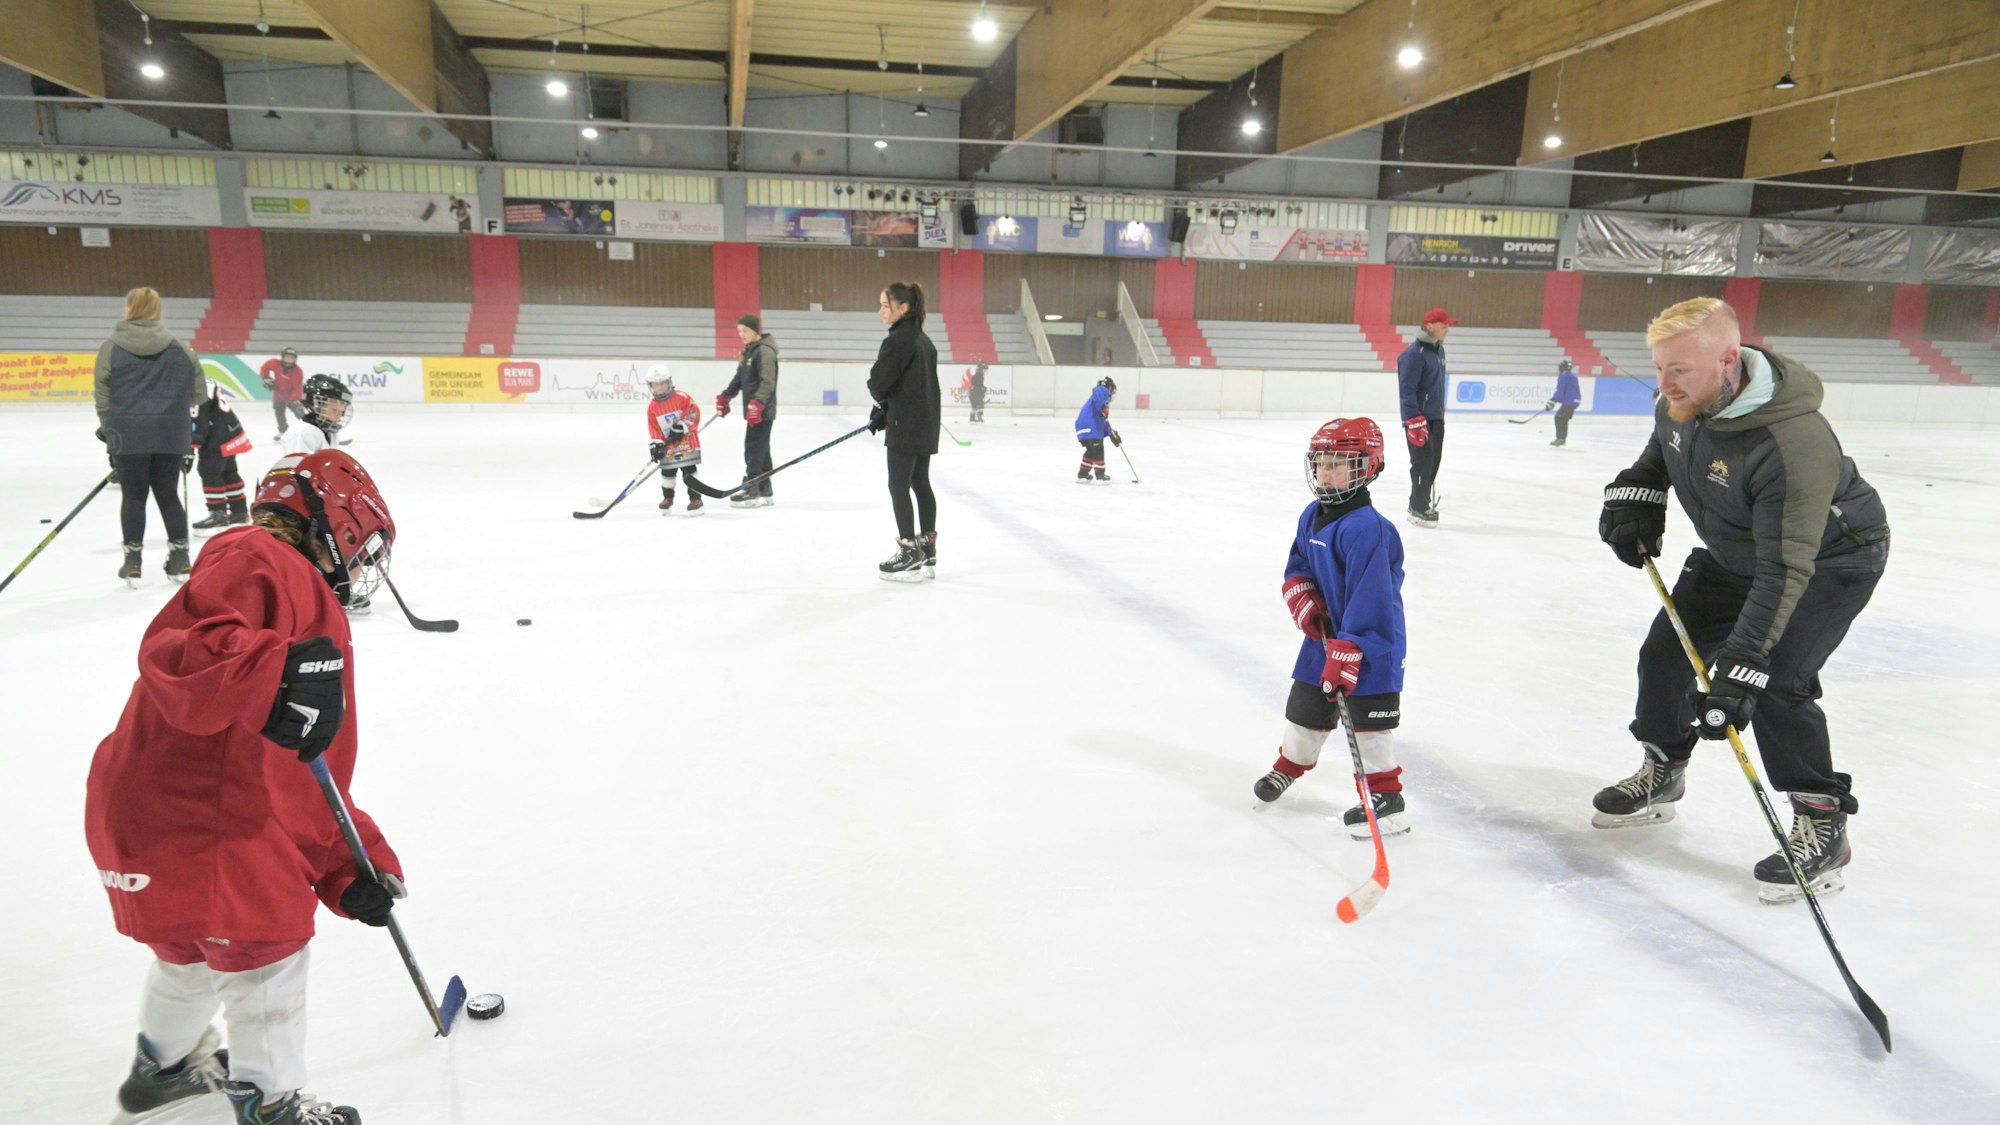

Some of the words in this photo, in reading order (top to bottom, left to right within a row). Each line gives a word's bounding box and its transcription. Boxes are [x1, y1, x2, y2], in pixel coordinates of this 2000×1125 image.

[62, 188, 122, 206] KMS
[488, 220, 498, 233] F
[1421, 239, 1460, 248] HENRICH
[1562, 258, 1572, 269] E
[429, 371, 482, 379] GEMEINSAM
[503, 368, 534, 377] REWE
[430, 379, 448, 388] FÜR
[449, 380, 484, 389] UNSERE
